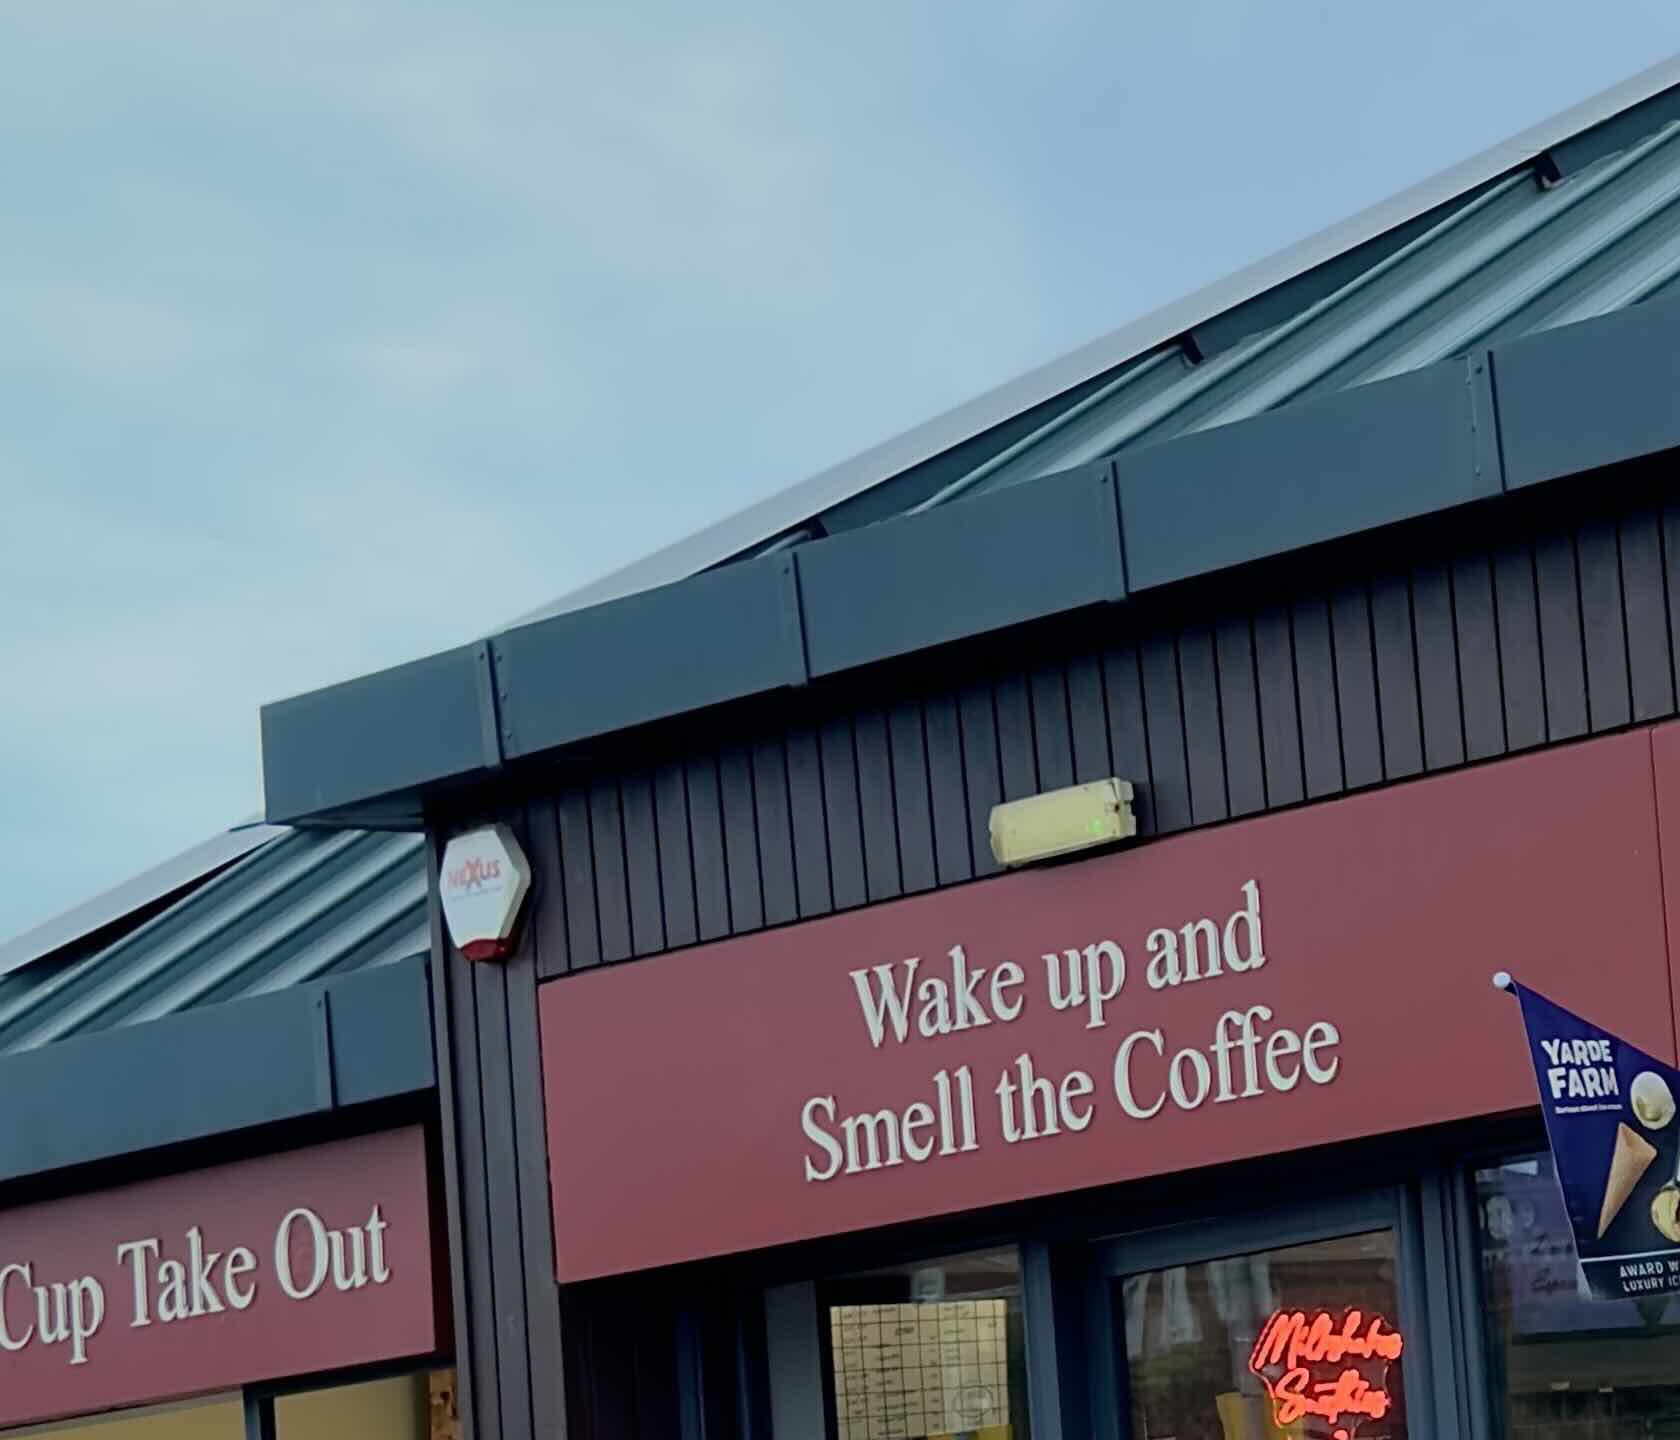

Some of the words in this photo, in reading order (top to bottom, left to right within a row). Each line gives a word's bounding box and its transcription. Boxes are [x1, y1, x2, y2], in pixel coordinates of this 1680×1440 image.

[850, 946, 1026, 1048] Wake
[1045, 939, 1126, 1030] up
[1145, 879, 1267, 990] and
[1540, 1038, 1613, 1066] YARDE
[800, 1065, 977, 1183] Smell
[995, 1053, 1095, 1143] the
[1113, 1003, 1342, 1120] Coffee
[1547, 1066, 1619, 1099] FARM
[0, 1263, 104, 1365] Cup
[117, 1226, 258, 1328] Take
[275, 1204, 391, 1301] Out
[1619, 1261, 1664, 1278] AWARD
[1622, 1276, 1665, 1292] LUXURY
